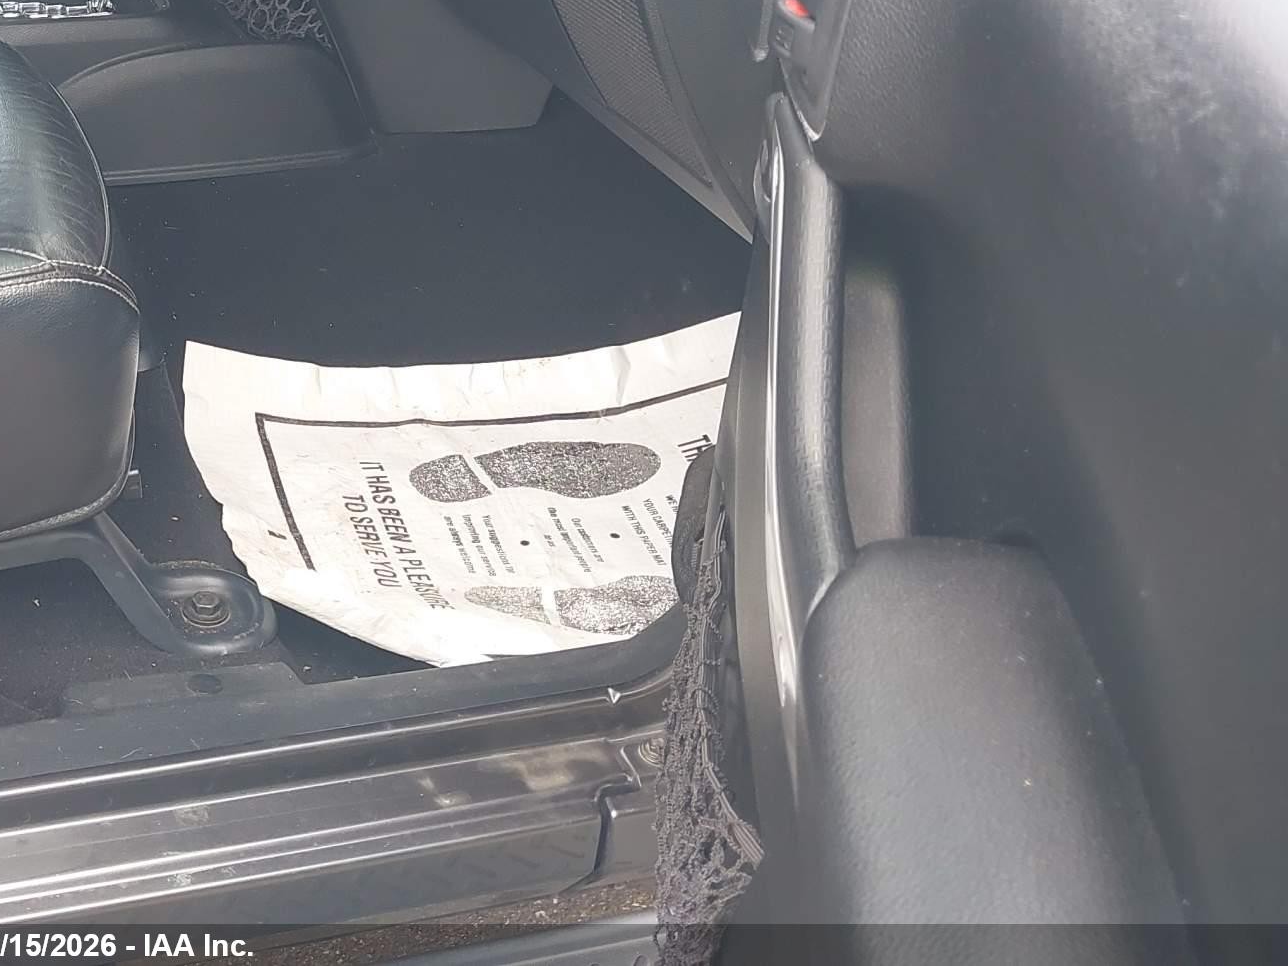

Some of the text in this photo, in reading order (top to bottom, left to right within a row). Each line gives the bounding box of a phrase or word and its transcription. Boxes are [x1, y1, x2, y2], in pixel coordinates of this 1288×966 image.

[482, 514, 494, 528] Your
[643, 498, 658, 517] YOUR
[342, 494, 403, 588] TO SERVE YOU
[359, 461, 456, 609] IT HAS BEEN A PLEASURE
[622, 505, 636, 521] WITH
[631, 521, 646, 535] THIS
[640, 535, 658, 554] PAPER
[481, 555, 497, 576] service
